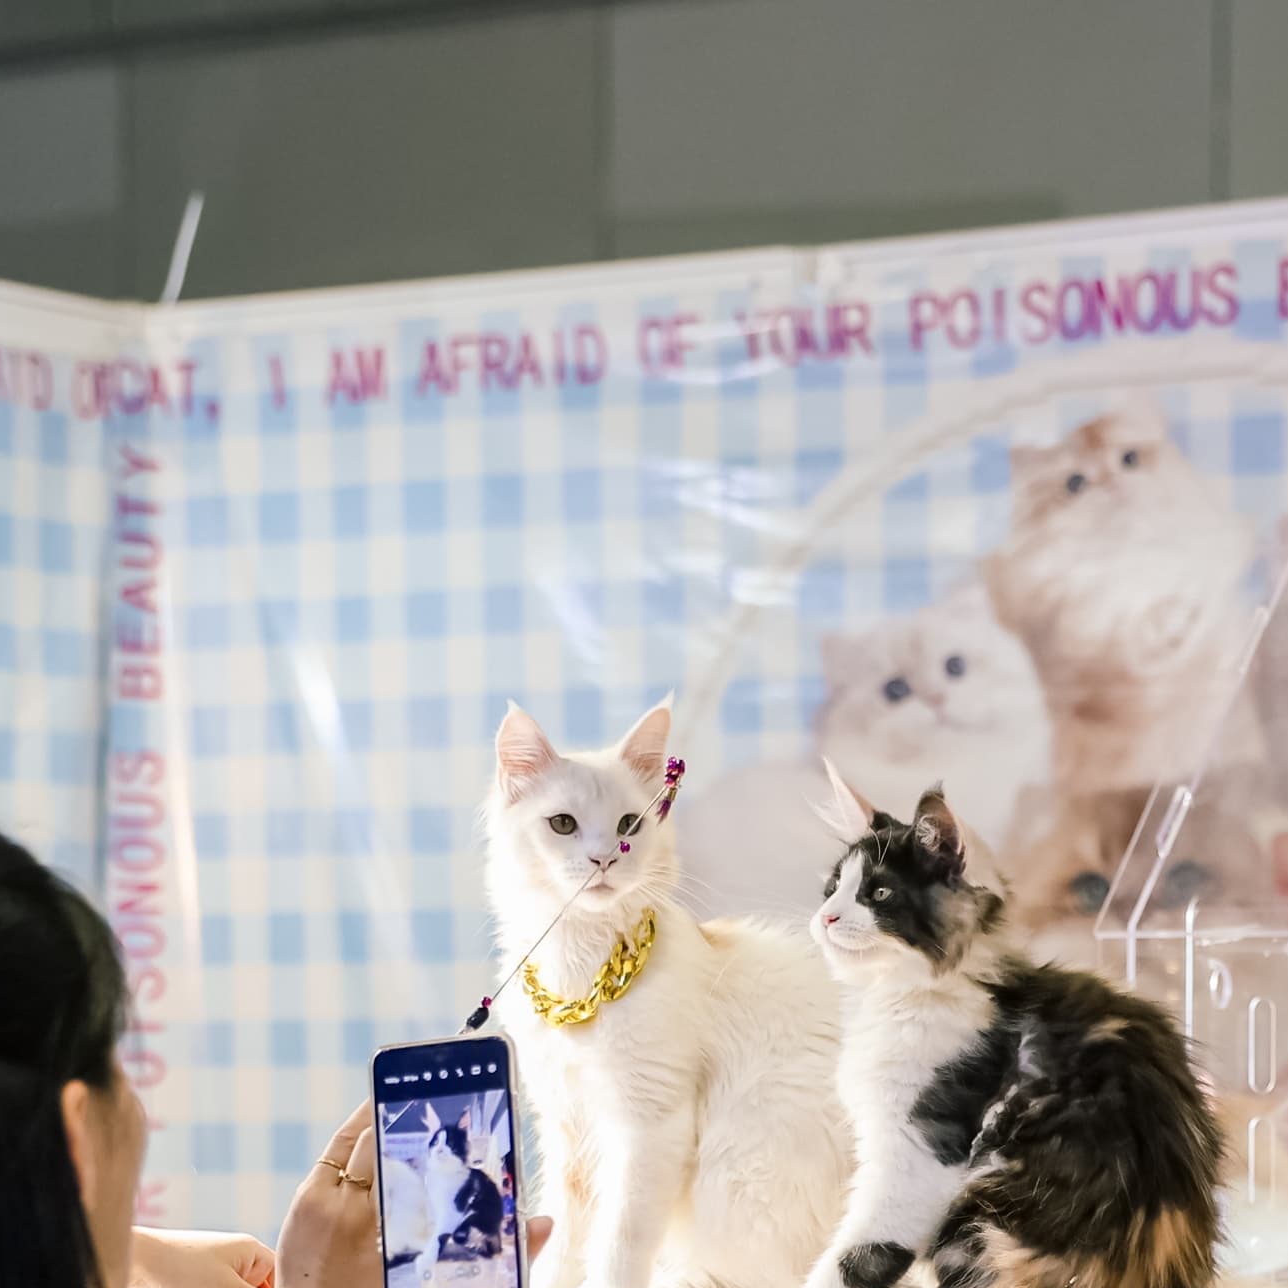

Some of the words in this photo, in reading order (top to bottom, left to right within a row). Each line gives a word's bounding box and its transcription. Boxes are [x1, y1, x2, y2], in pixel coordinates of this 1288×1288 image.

[269, 356, 286, 410] I
[328, 345, 389, 405] AM
[415, 323, 608, 394] AFRAID
[741, 298, 875, 365] YOUR
[911, 263, 1242, 351] POISONOUS
[115, 445, 165, 702] BEAUTY
[110, 748, 166, 1130] OISONOUS
